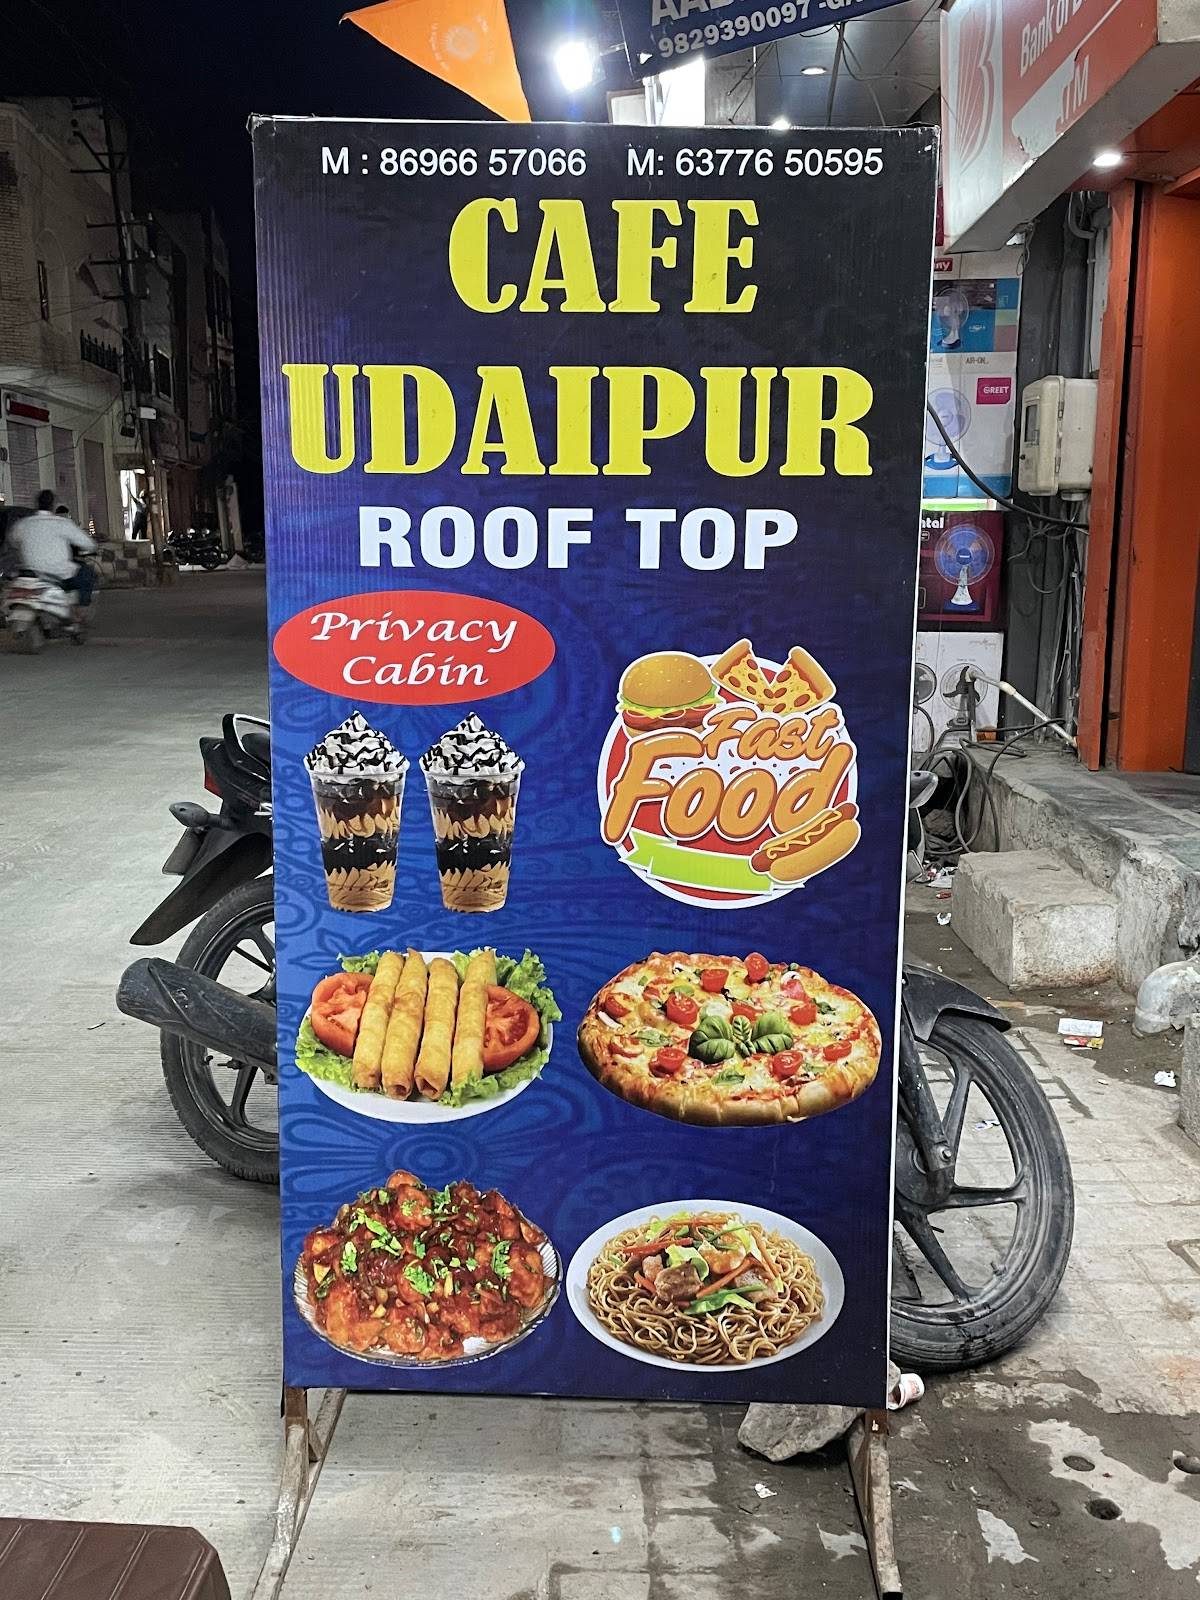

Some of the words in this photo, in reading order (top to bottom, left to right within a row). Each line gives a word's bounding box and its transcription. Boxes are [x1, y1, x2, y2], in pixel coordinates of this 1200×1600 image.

[658, 0, 811, 58] 9829390097
[1020, 0, 1053, 78] Bank
[321, 146, 349, 174] M
[379, 148, 478, 176] 86966
[488, 148, 587, 176] 57066
[627, 148, 664, 176] M:
[675, 148, 774, 176] 63776
[784, 148, 884, 176] 50595
[449, 197, 759, 313] CAFE
[935, 261, 950, 271] ny
[282, 363, 874, 477] UDAIPUR
[359, 506, 593, 569] ROOF
[625, 508, 798, 571] TOP
[310, 611, 518, 653] Privacy
[342, 652, 489, 686] Cabin
[702, 707, 842, 761] Fast
[604, 731, 854, 843] Food
